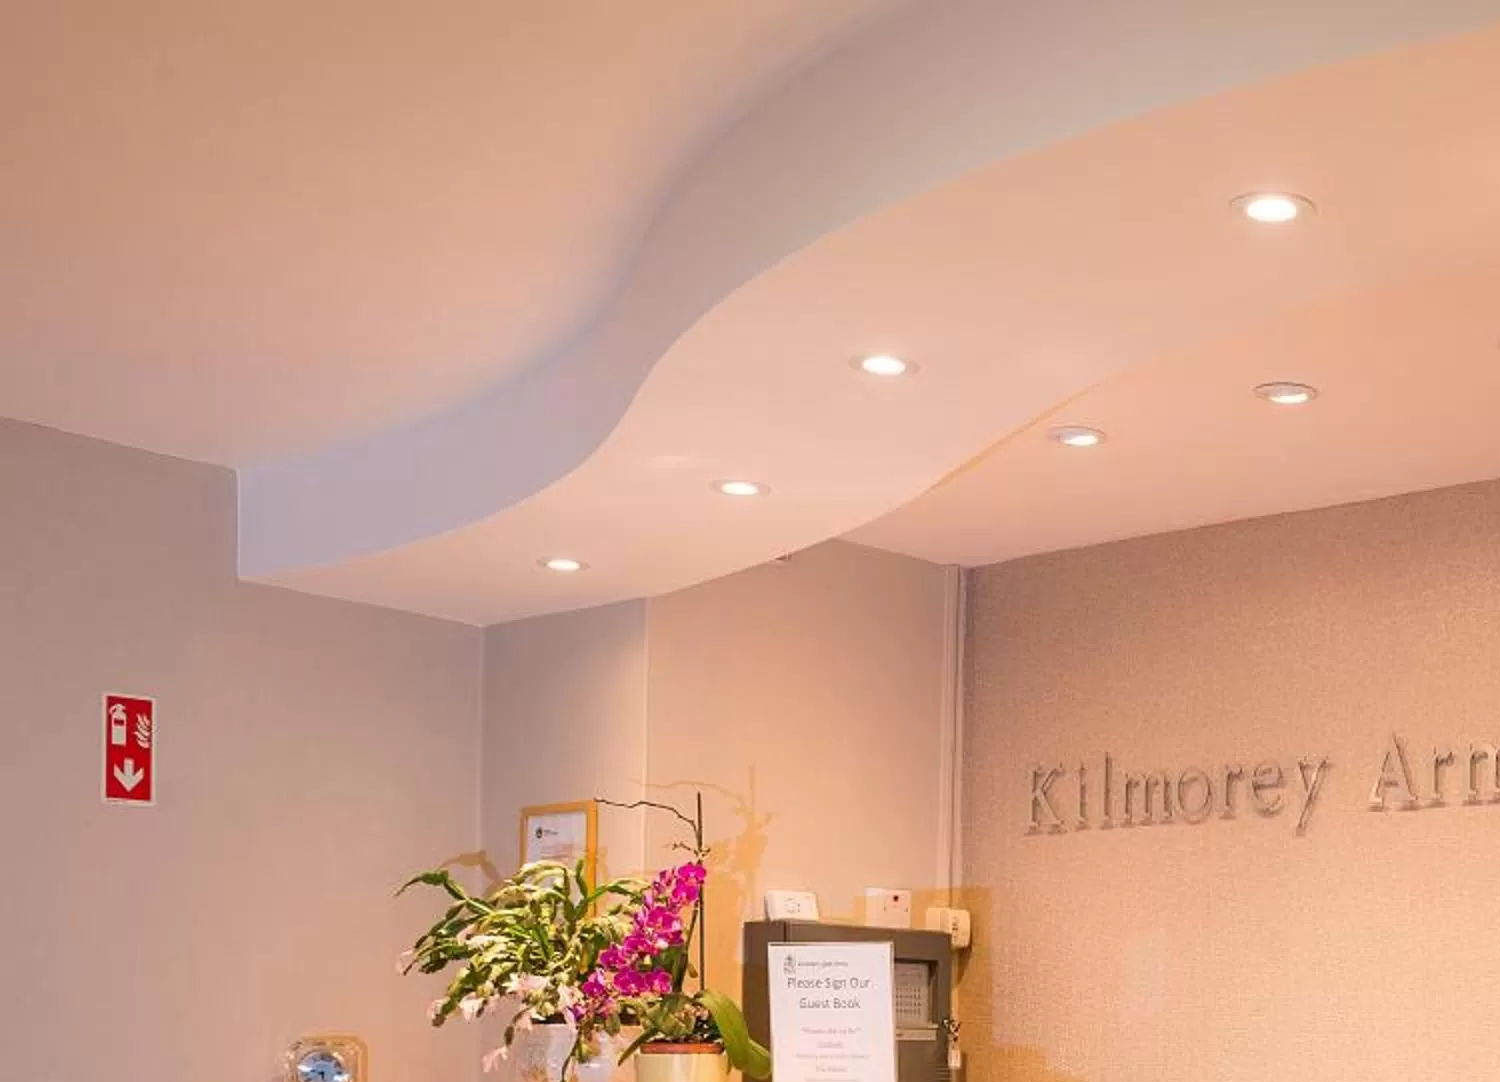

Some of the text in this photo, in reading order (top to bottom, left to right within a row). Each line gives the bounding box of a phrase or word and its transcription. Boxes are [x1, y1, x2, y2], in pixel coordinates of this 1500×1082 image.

[1025, 752, 1333, 836] Kilmorey
[787, 977, 870, 990] Please Sign Our
[799, 997, 861, 1008] Guest Book
